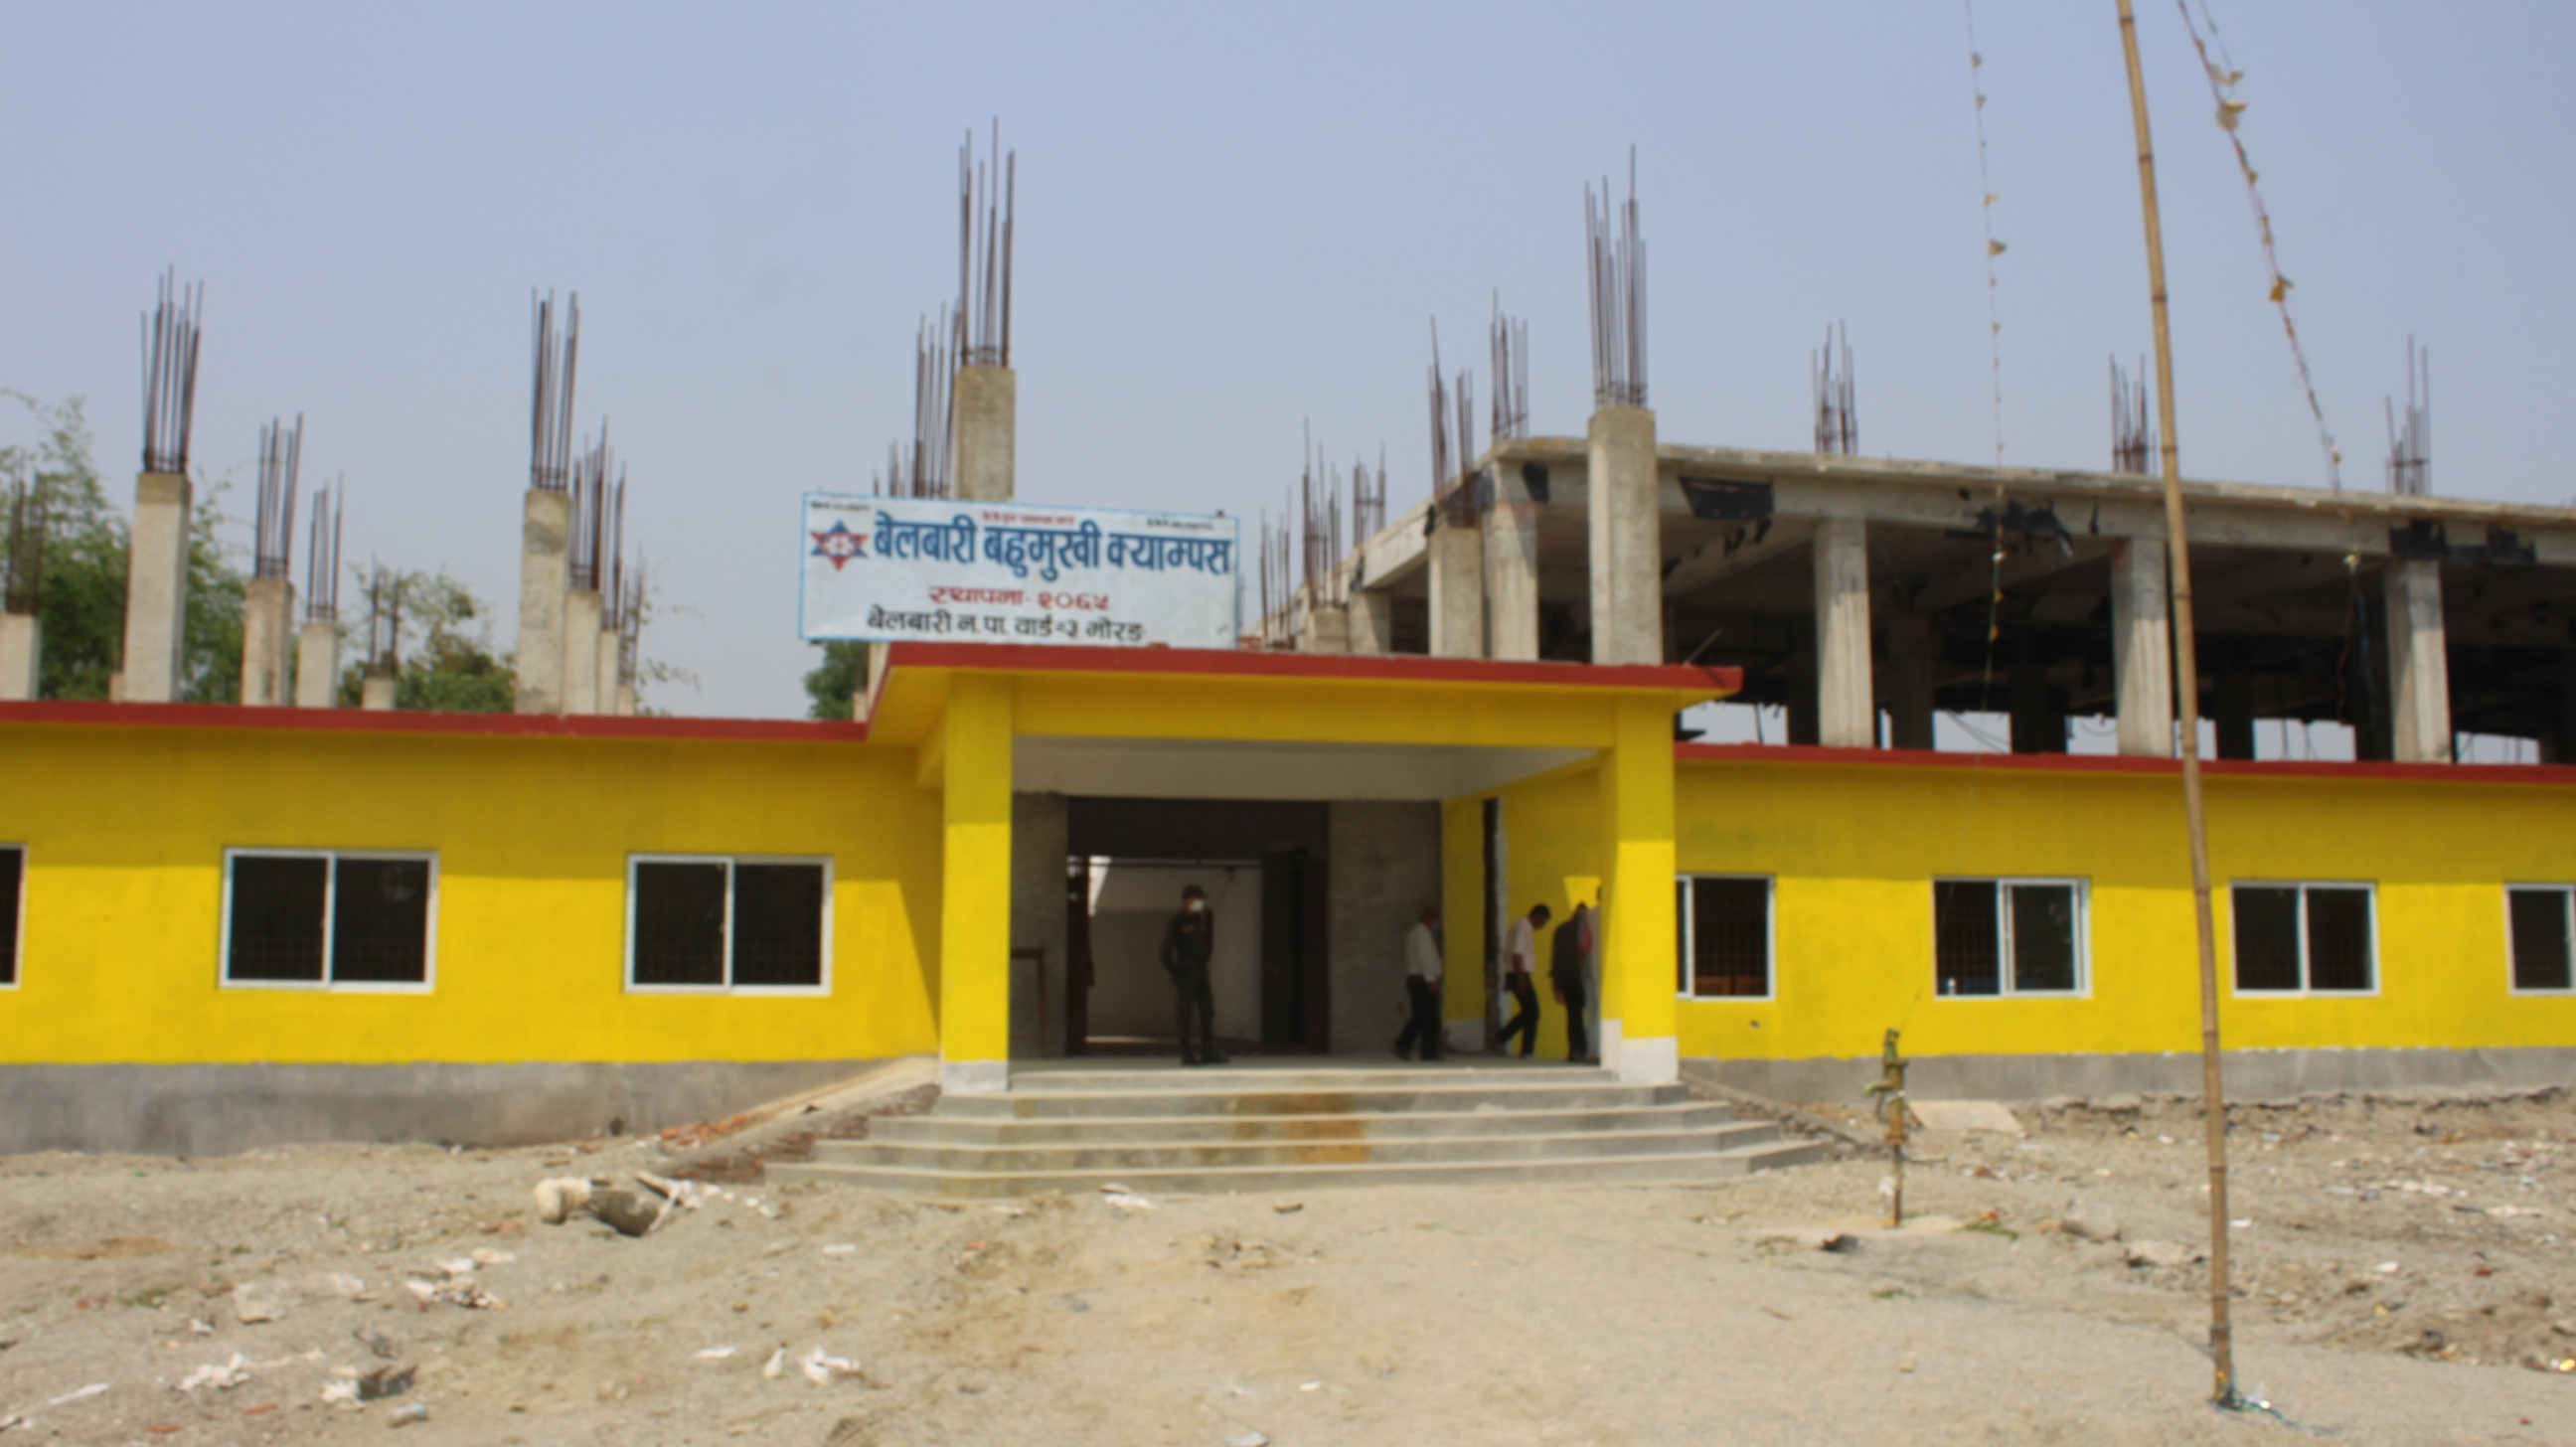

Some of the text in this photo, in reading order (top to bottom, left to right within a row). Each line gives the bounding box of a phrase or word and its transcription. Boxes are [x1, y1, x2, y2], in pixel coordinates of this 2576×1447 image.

[874, 511, 1234, 582] बेलबारी बहुमुखी क्याम्पस
[868, 603, 953, 633] बेलबारी
